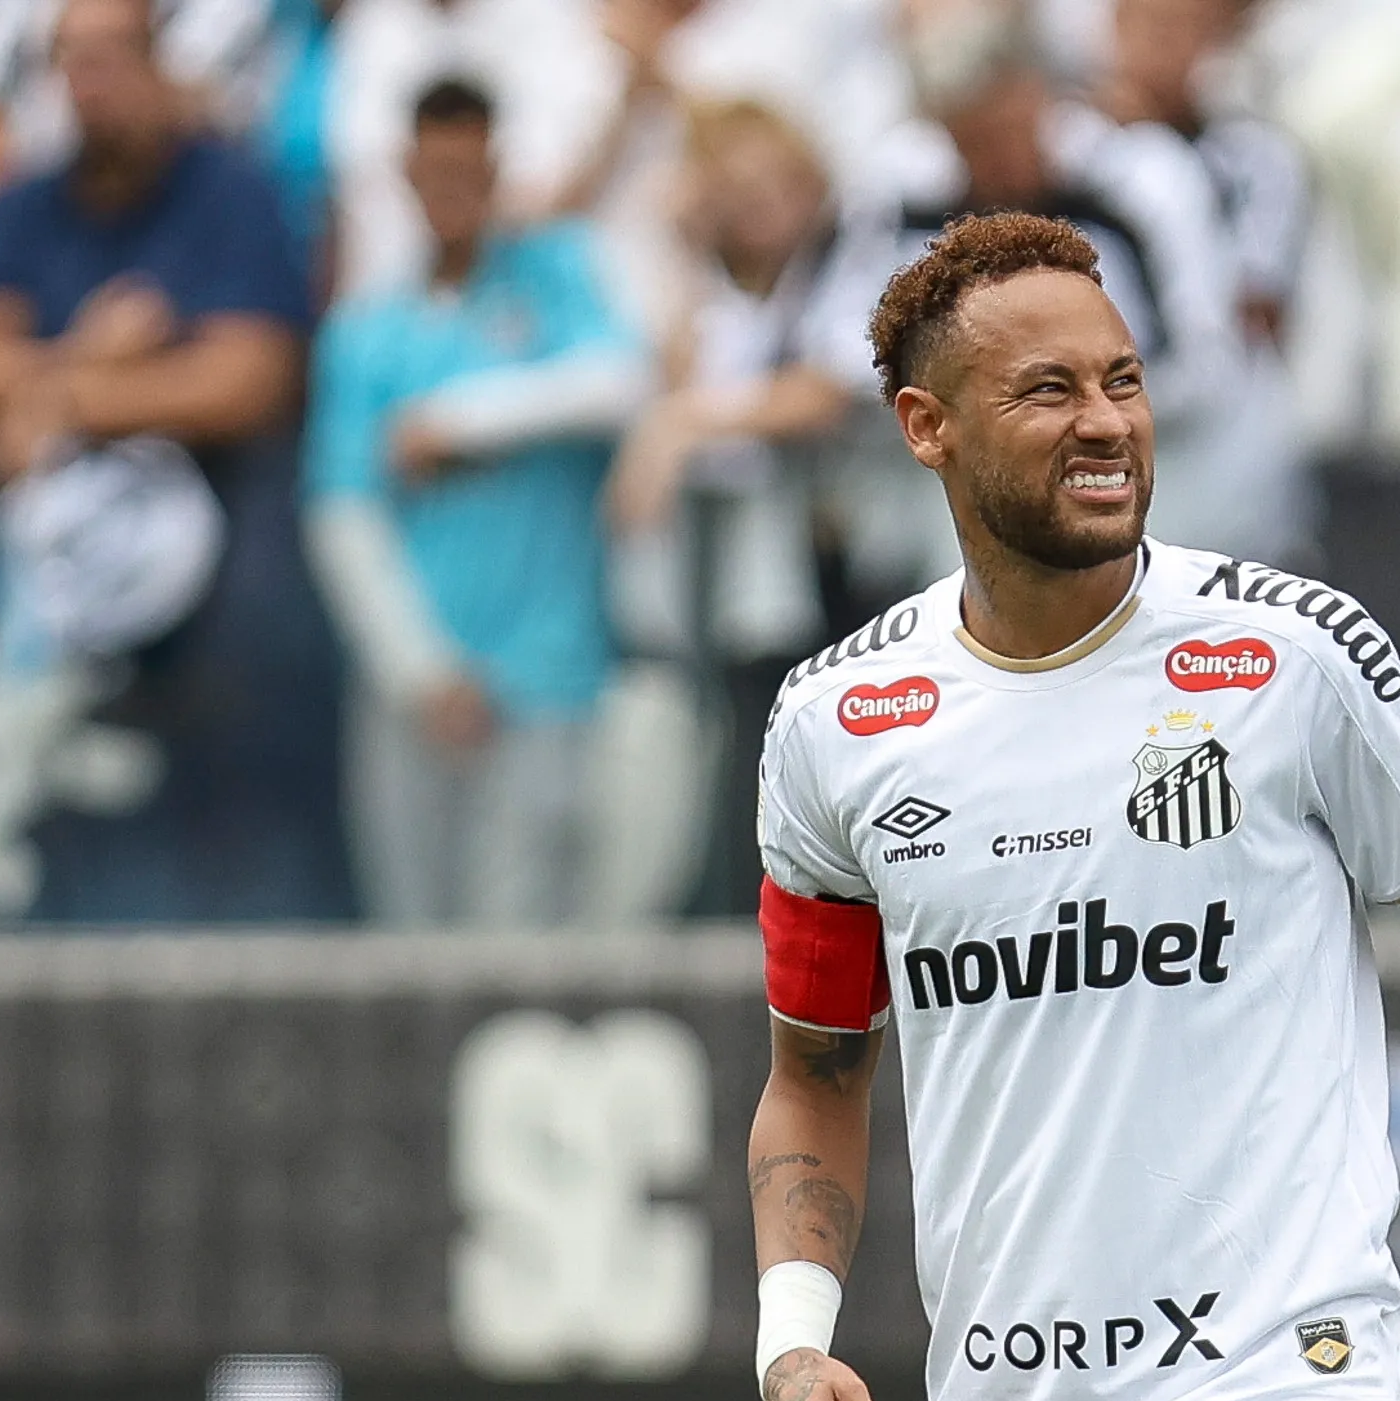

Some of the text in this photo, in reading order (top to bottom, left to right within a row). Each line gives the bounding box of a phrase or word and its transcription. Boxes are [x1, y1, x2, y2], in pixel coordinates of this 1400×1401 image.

[1171, 650, 1271, 681] Canção
[842, 688, 935, 720] Canção
[884, 841, 946, 864] umbro
[904, 898, 1235, 1010] novibet
